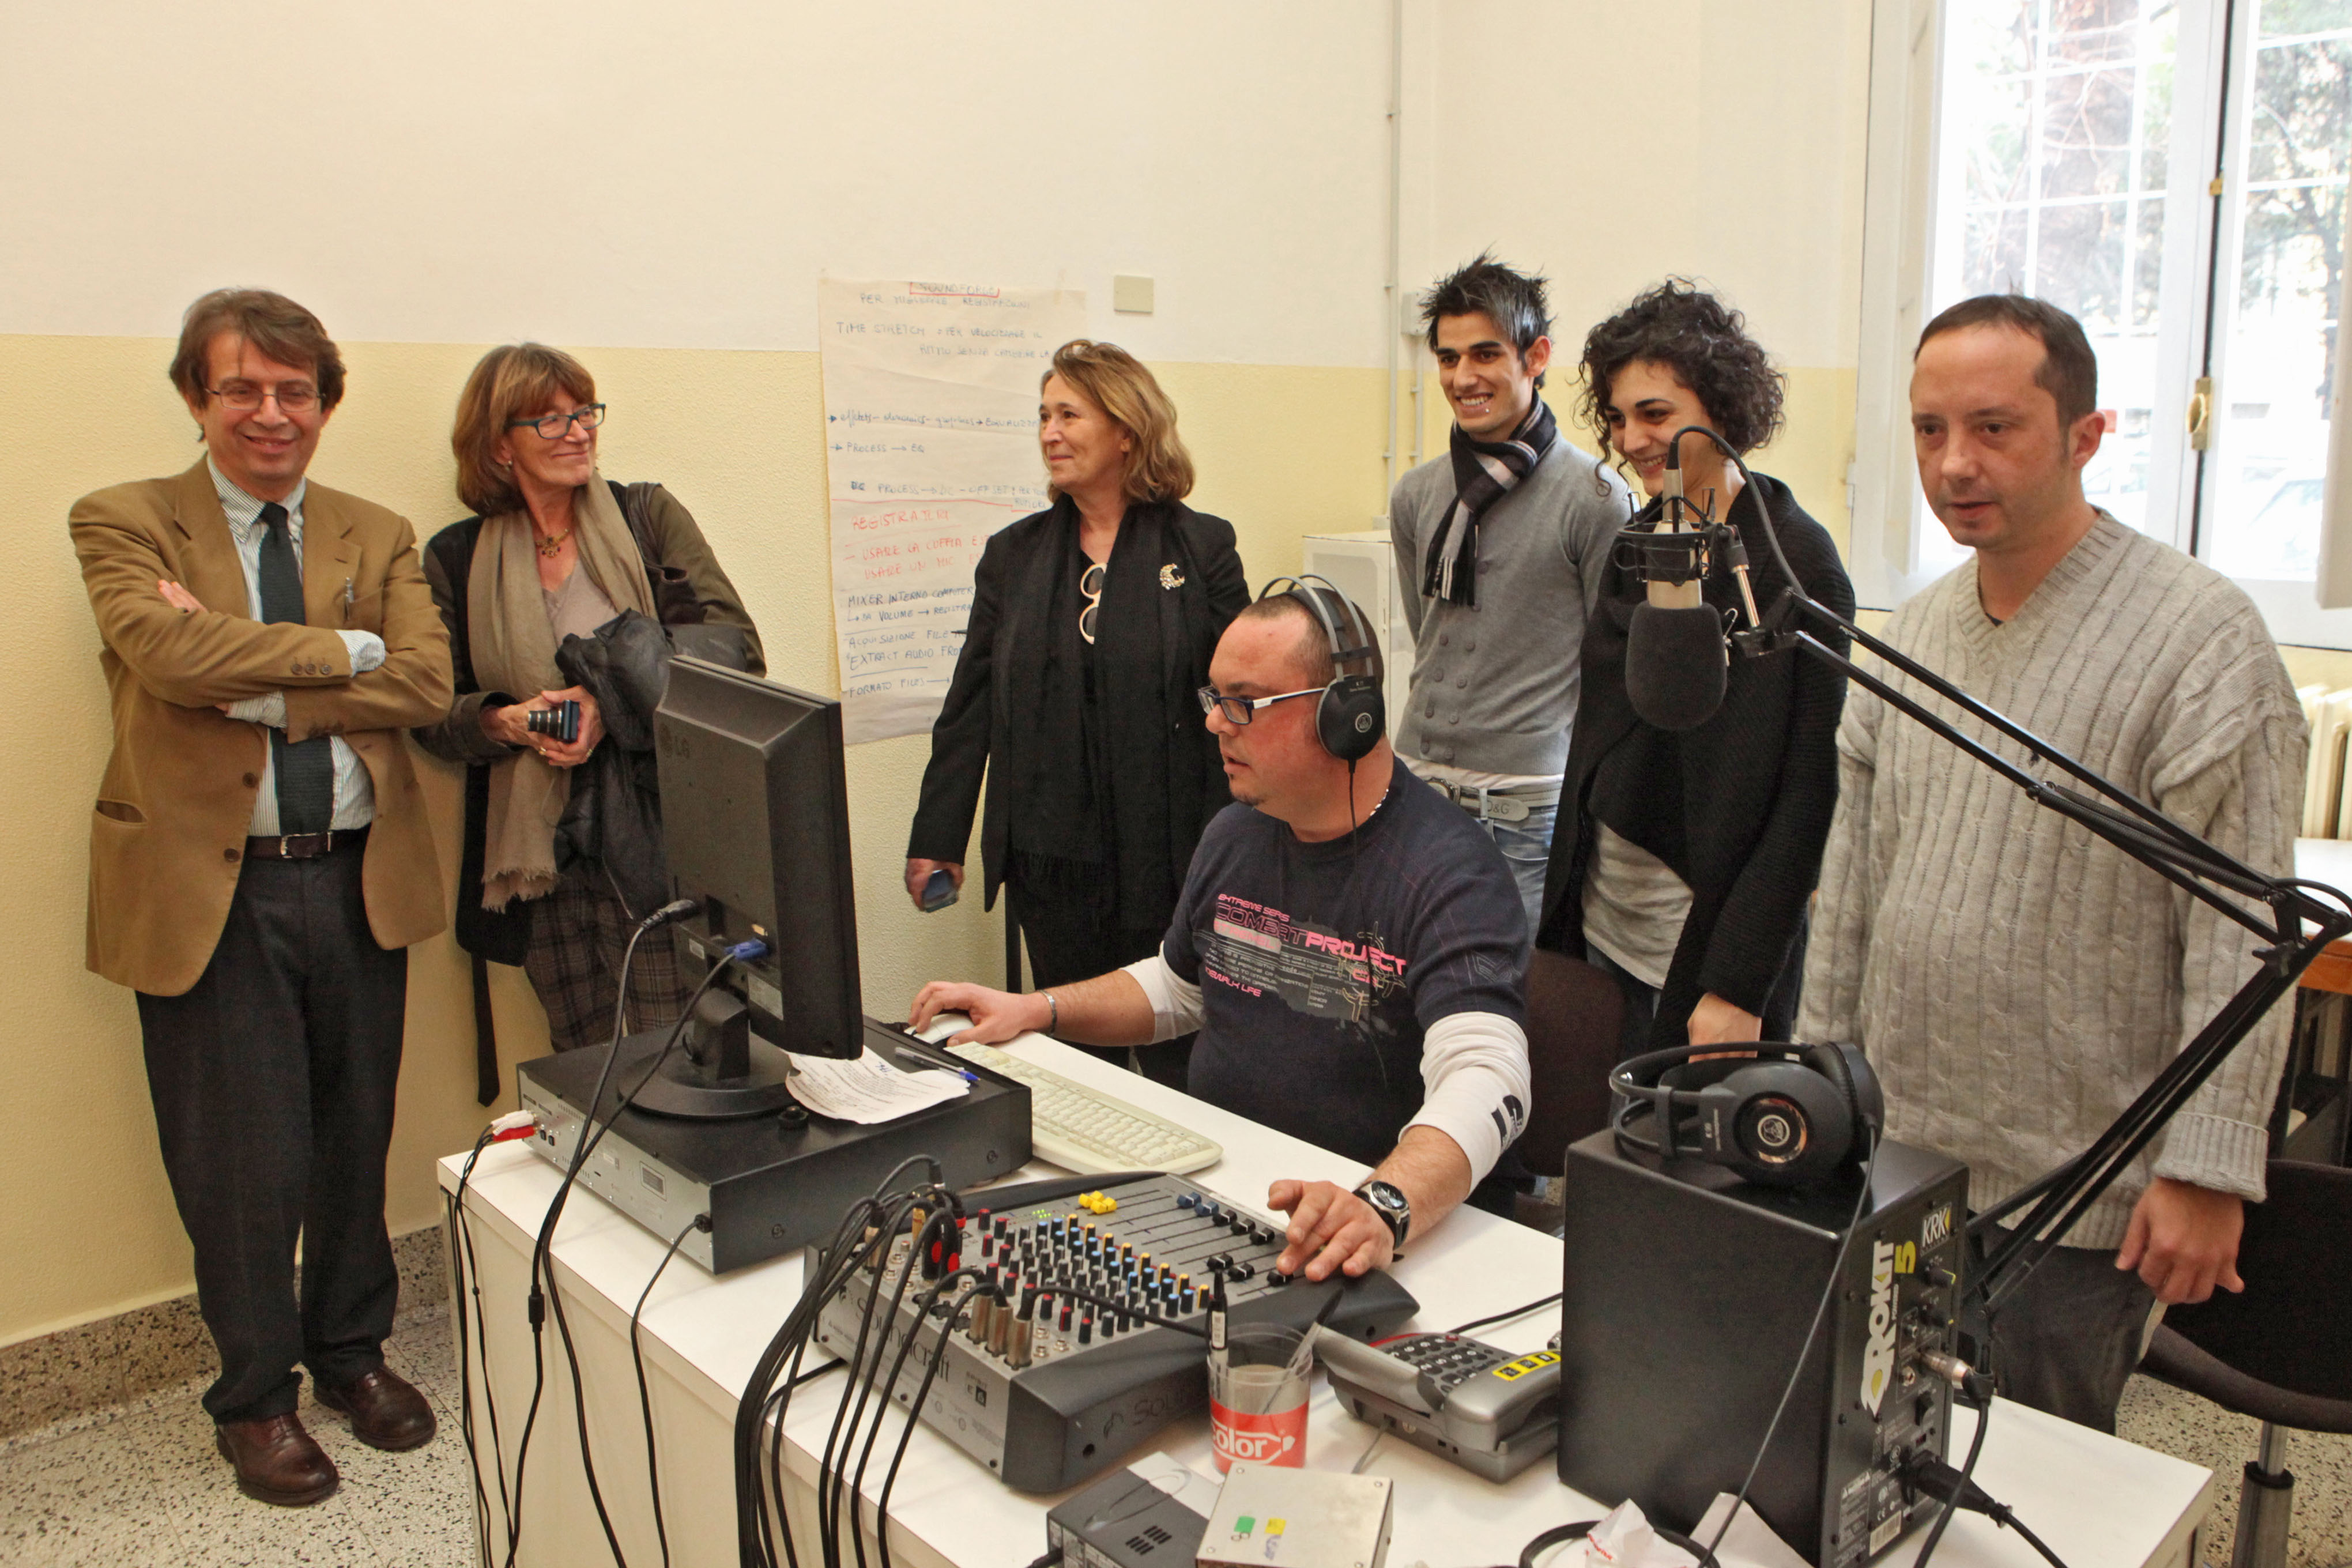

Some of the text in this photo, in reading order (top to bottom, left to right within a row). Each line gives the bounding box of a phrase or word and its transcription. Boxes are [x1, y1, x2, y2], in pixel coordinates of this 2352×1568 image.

[860, 293, 884, 304] PER
[836, 321, 866, 335] TIME
[846, 442, 887, 453] PROCESS
[878, 483, 919, 495] PROCESS
[862, 545, 901, 561] USARE
[864, 563, 903, 580] USARE
[847, 594, 883, 608] MIXER
[879, 609, 914, 622] VOLUME
[904, 648, 934, 659] AUDIO
[1216, 902, 1307, 945] COMBAT
[1304, 931, 1407, 976] PROJECT
[1241, 983, 1262, 997] LIFE
[1922, 1207, 1947, 1247] KRK
[1894, 1240, 1916, 1275] 5
[1861, 1240, 1897, 1418] ROKIT
